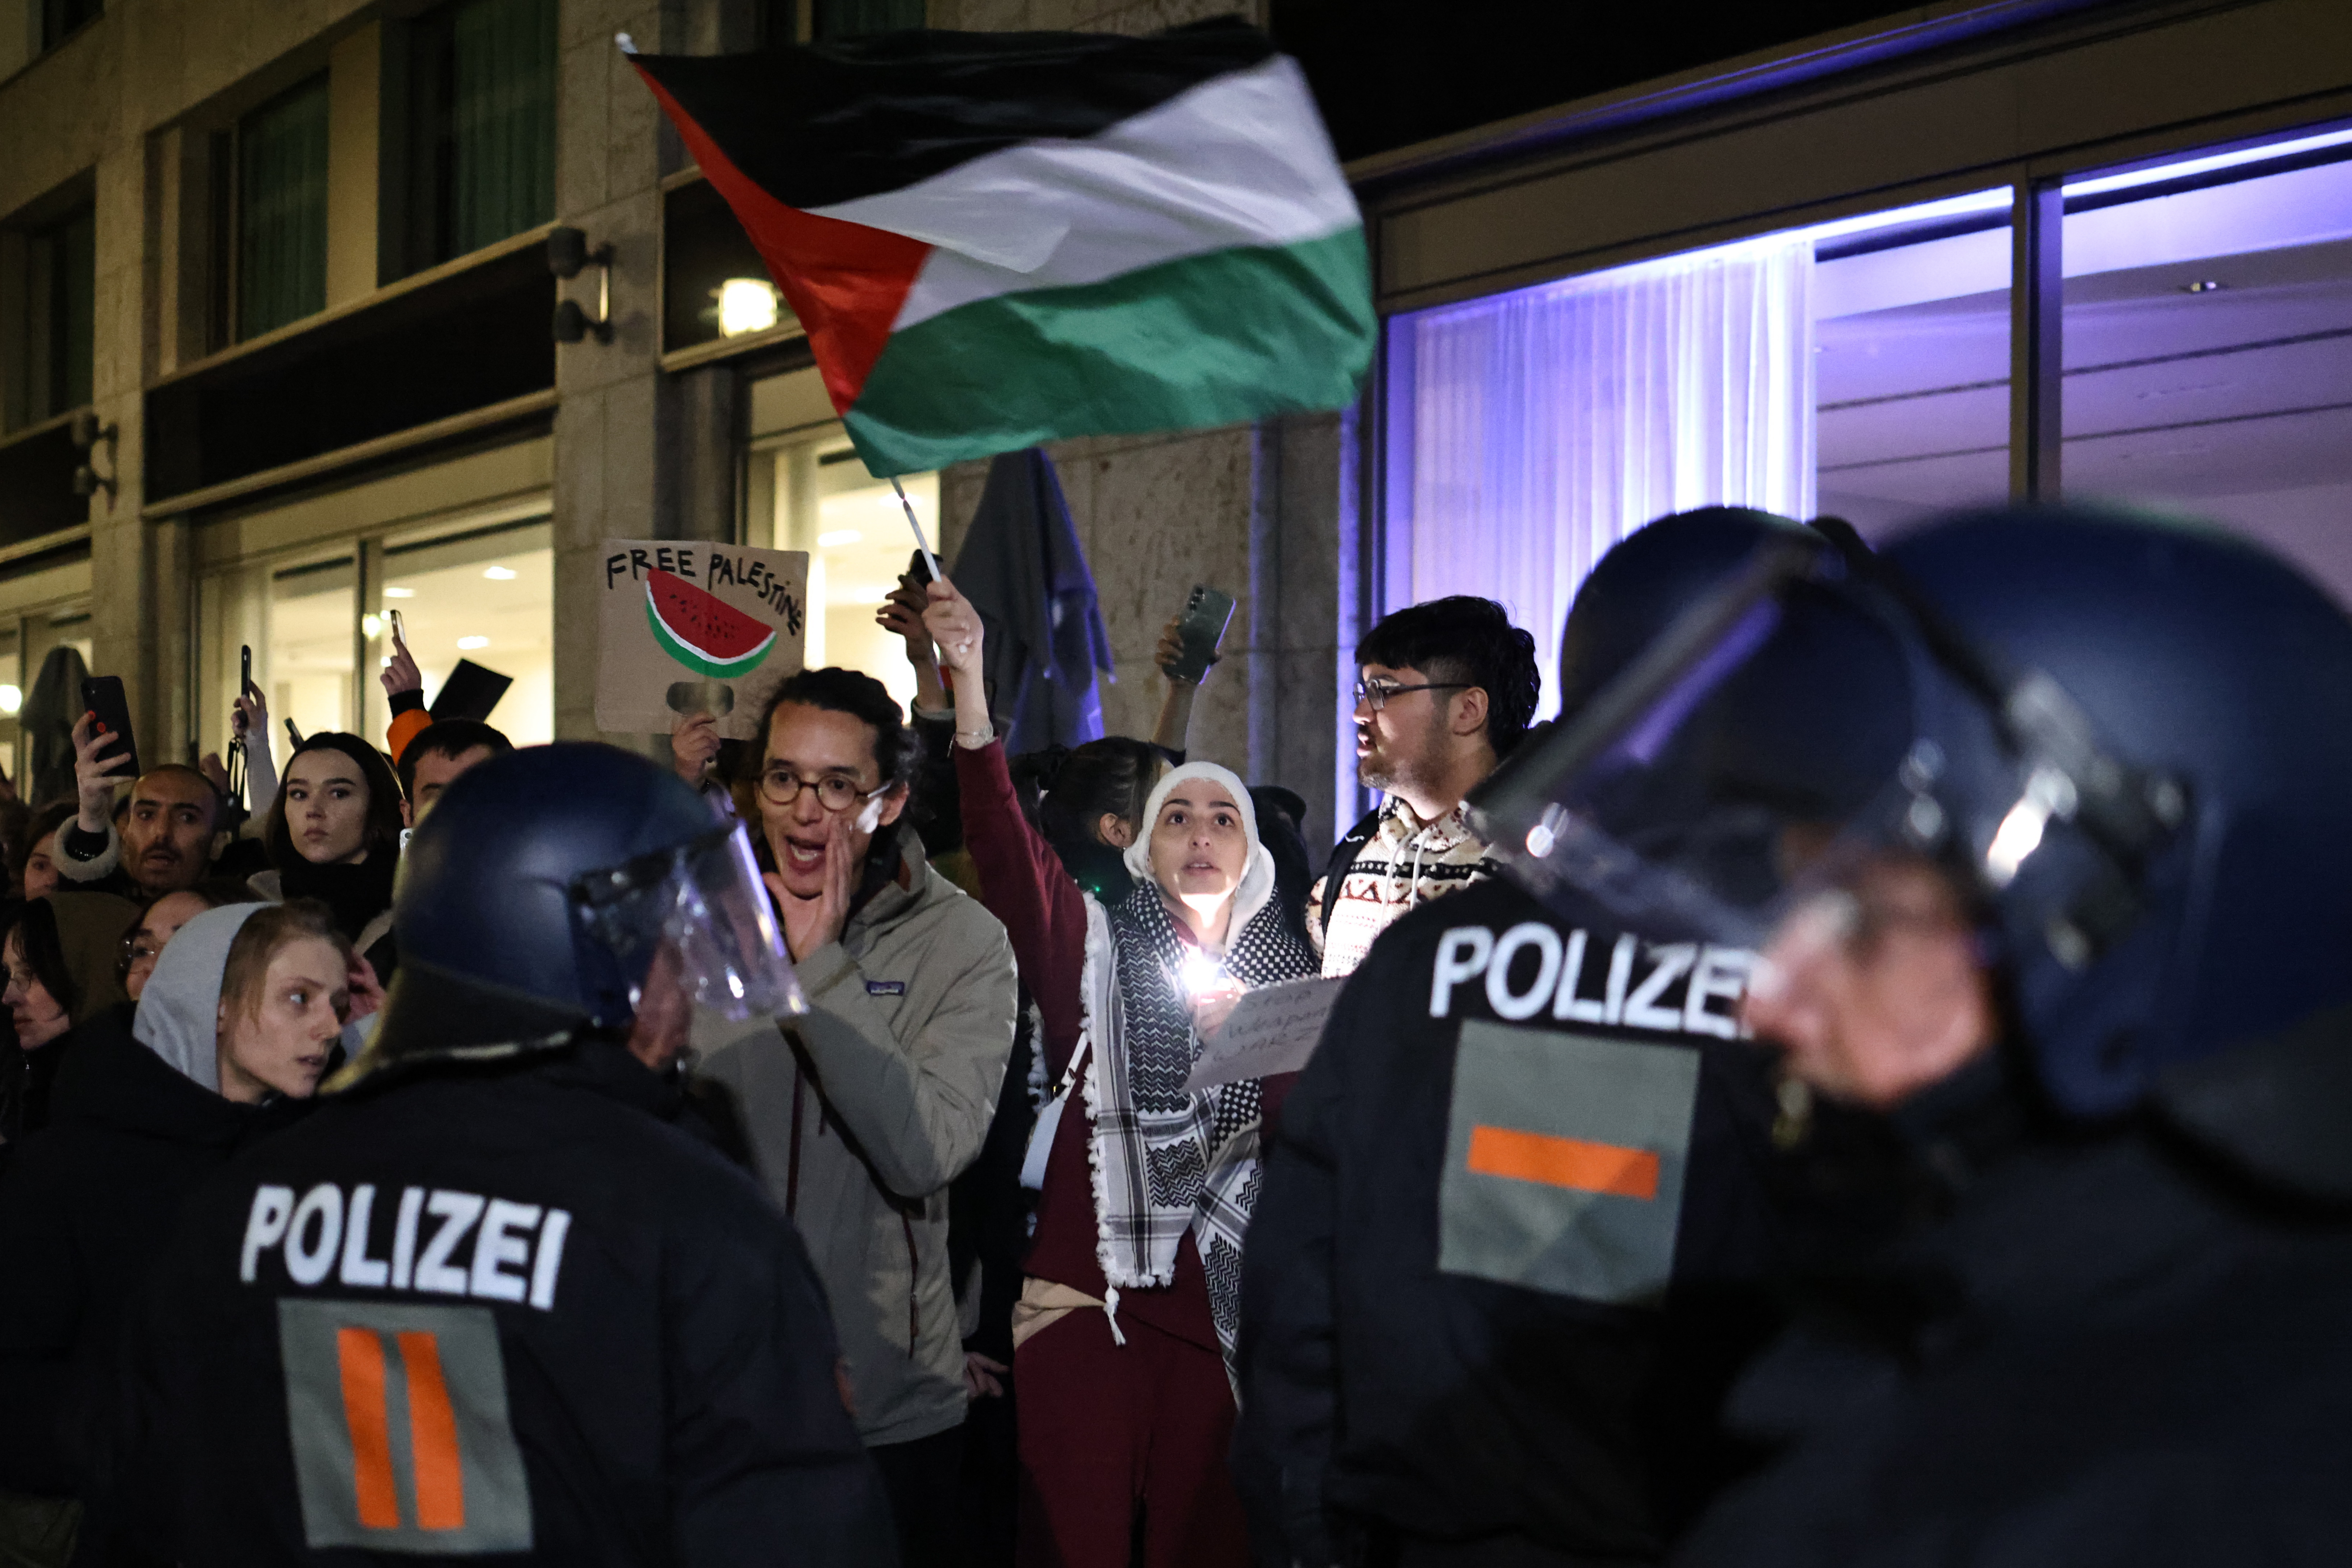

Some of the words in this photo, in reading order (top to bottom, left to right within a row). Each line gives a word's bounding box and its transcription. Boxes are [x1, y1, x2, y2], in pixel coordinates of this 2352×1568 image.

[606, 547, 696, 590] FREE
[708, 554, 801, 636] PALESTINE
[1428, 922, 1755, 1041] POLIZE
[239, 1181, 573, 1312] POLIZEI
